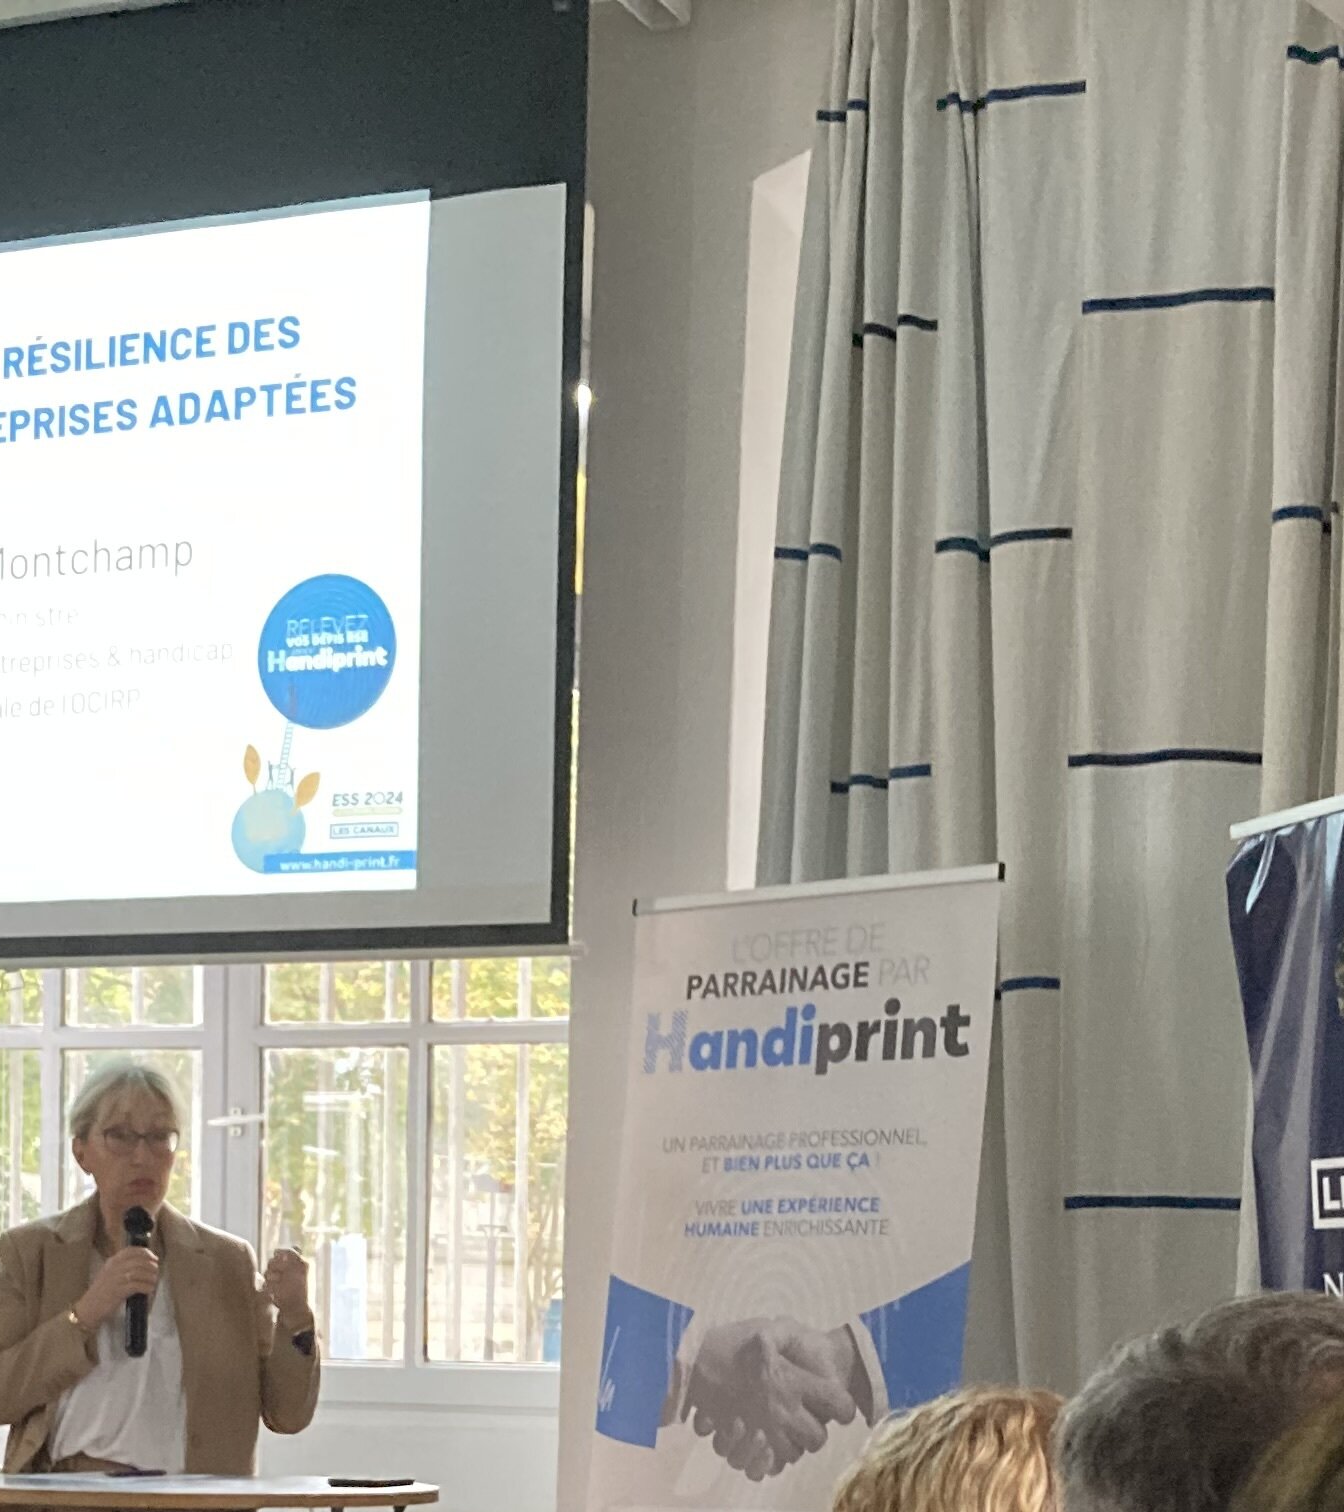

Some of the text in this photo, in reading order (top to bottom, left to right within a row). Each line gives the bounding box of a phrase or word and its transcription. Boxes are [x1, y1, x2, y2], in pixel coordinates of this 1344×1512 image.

[2, 324, 217, 380] RÉSILIENCE
[227, 316, 301, 355] DES
[149, 373, 357, 429] ADAPTÉES
[106, 645, 122, 667] &
[267, 644, 388, 673] Handiprint
[28, 695, 55, 719] de
[332, 791, 403, 807] ESS 2024
[733, 922, 886, 963] L'OFFRE DE
[686, 957, 931, 1000] PARRAINAGE PAR
[643, 997, 971, 1075] Handiprint
[663, 1136, 685, 1153] UN
[689, 1132, 786, 1152] PARRAINAGE
[702, 1157, 720, 1174] ET
[724, 1155, 760, 1173] BIEN
[764, 1154, 801, 1171] PLUS
[806, 1152, 842, 1169] QUE
[846, 1151, 870, 1172] ÇA
[695, 1200, 736, 1217] VIVRE
[741, 1199, 773, 1215] UNE
[684, 1218, 889, 1238] HUMAINE ENRICHISSANTE
